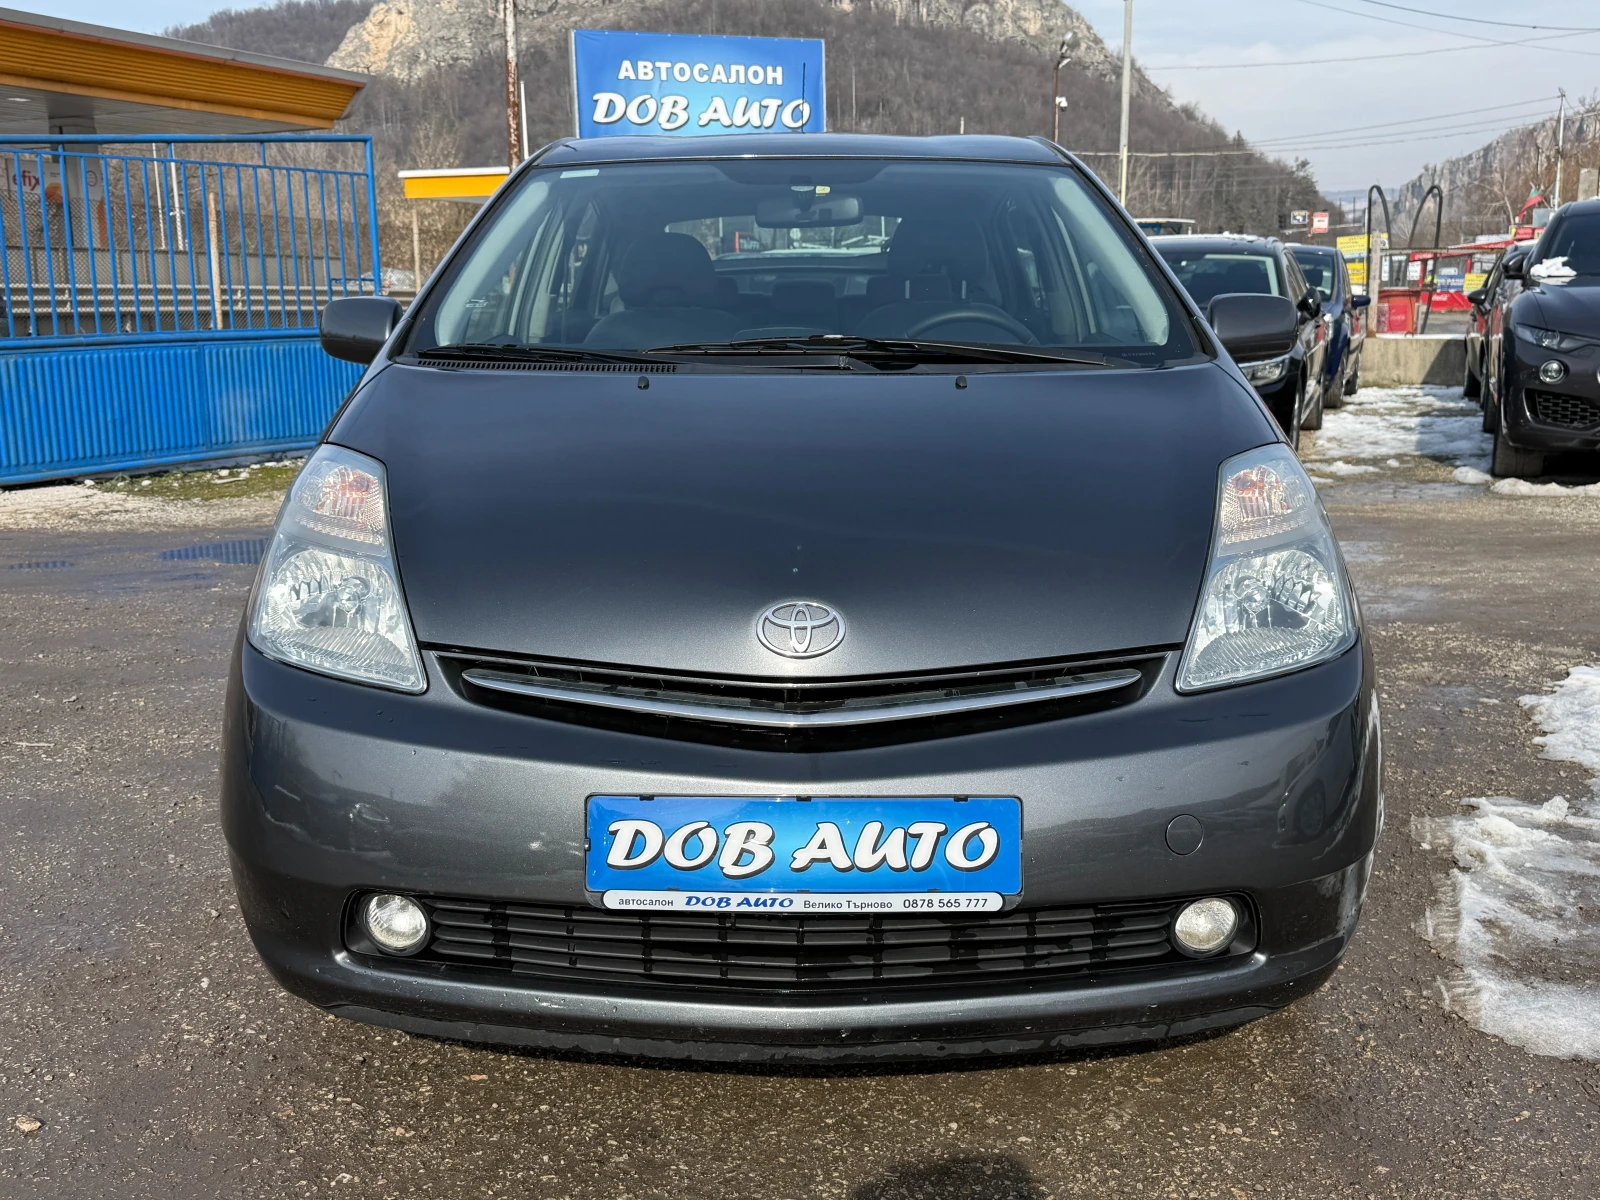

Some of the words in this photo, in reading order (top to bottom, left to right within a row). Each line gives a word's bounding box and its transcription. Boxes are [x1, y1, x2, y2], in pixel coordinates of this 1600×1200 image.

[618, 60, 783, 86] АВТОСАЛОН
[592, 92, 690, 130] DOB
[698, 96, 811, 129] AUTO
[606, 819, 775, 879] DOB
[789, 821, 999, 873] AUTO
[618, 898, 674, 907] автосалон
[685, 896, 732, 908] DOB
[735, 897, 794, 908] AUTO
[803, 900, 843, 909] Велико
[846, 900, 893, 910] Търново
[903, 899, 934, 909] 0878
[938, 899, 961, 908] 565
[965, 898, 988, 908] 777
